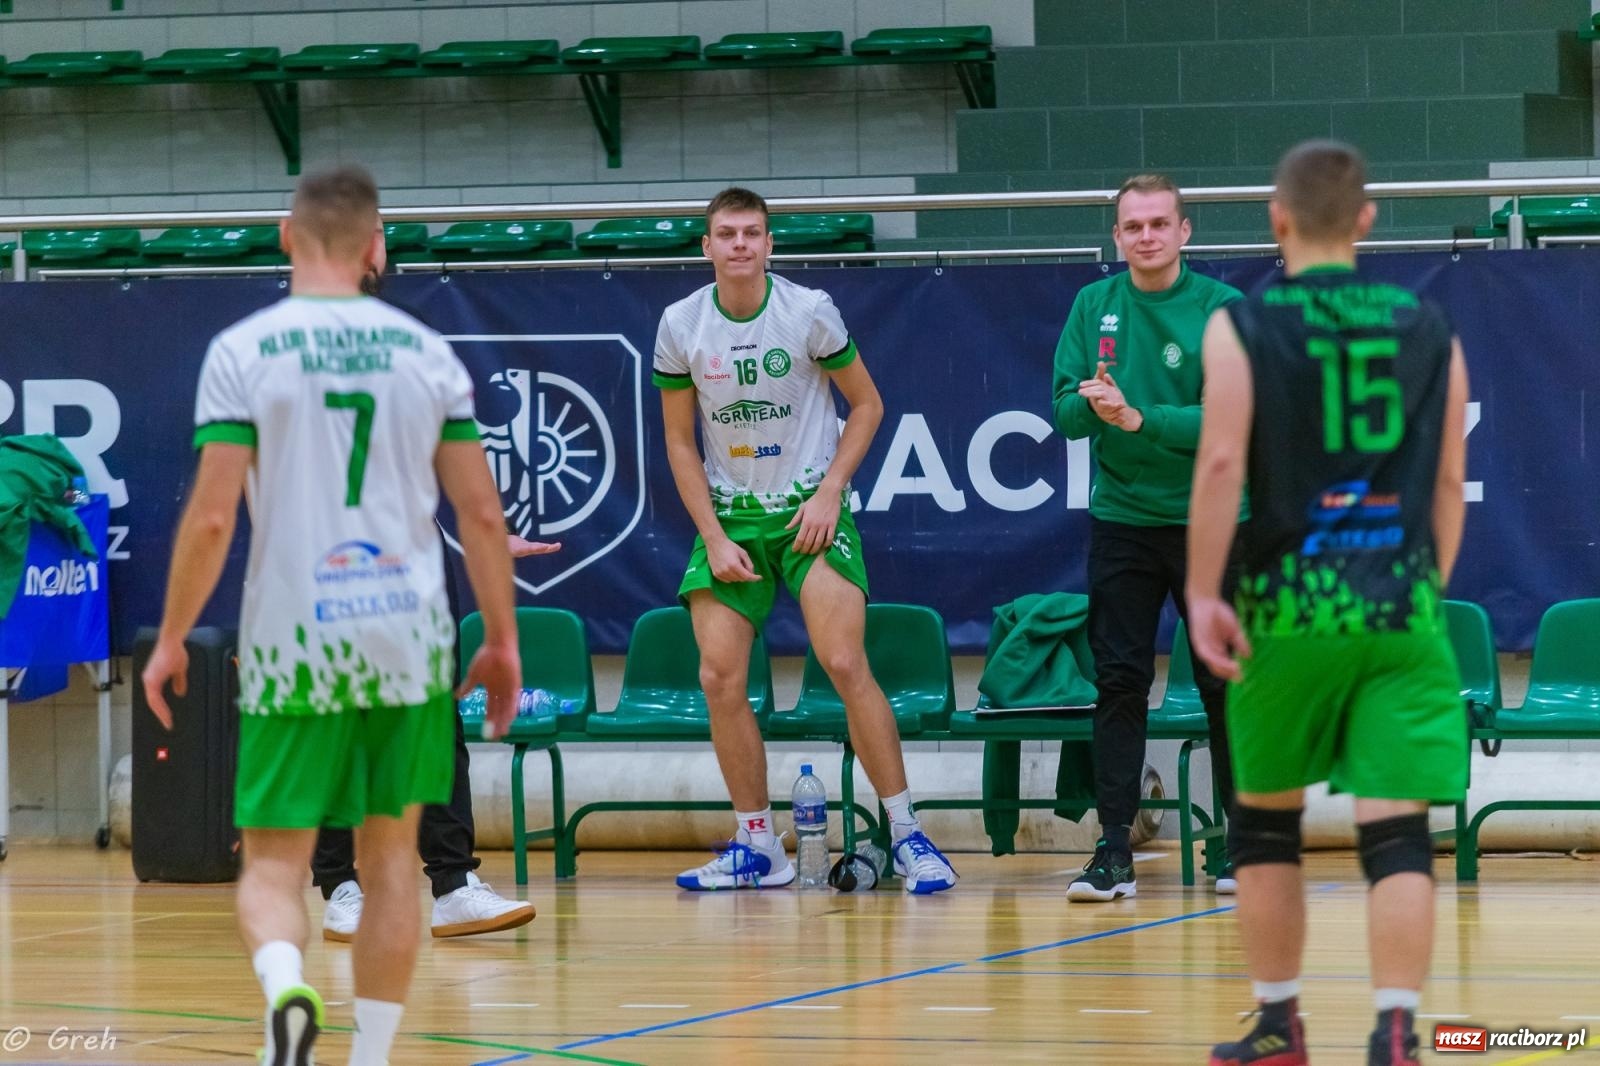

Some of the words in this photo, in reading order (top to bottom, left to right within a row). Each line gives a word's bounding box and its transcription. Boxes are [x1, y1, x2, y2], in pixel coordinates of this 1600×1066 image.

[733, 358, 758, 386] 16
[1099, 337, 1116, 358] R
[1306, 338, 1405, 454] 15
[325, 391, 375, 507] 7
